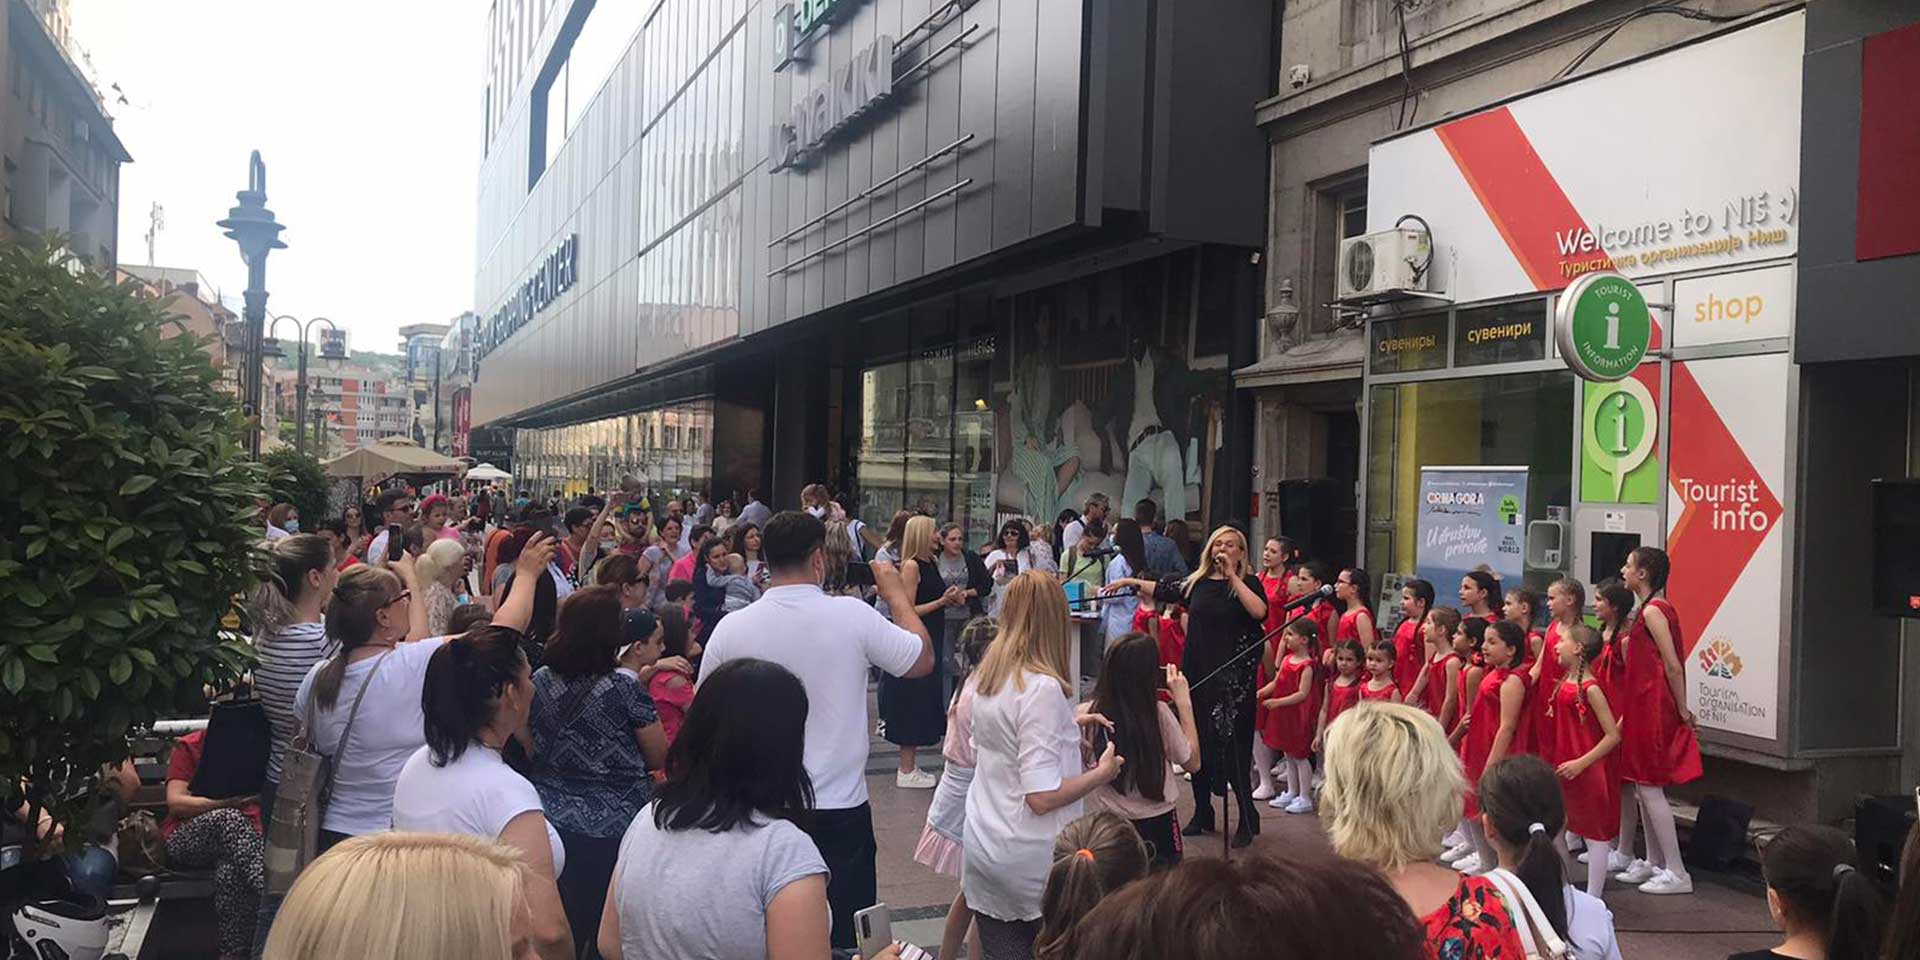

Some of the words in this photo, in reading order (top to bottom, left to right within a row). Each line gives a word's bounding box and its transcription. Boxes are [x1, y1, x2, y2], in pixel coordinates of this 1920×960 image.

[1556, 219, 1672, 256] Welcome
[1680, 208, 1711, 235] to
[532, 234, 577, 313] CENTER
[1595, 284, 1633, 300] TOURIST
[1695, 293, 1764, 324] shop
[1379, 335, 1436, 354] сувениры
[1467, 322, 1532, 344] сувенири
[1583, 341, 1639, 368] INFORMATION
[1679, 478, 1759, 502] Tourist
[1713, 502, 1768, 531] info
